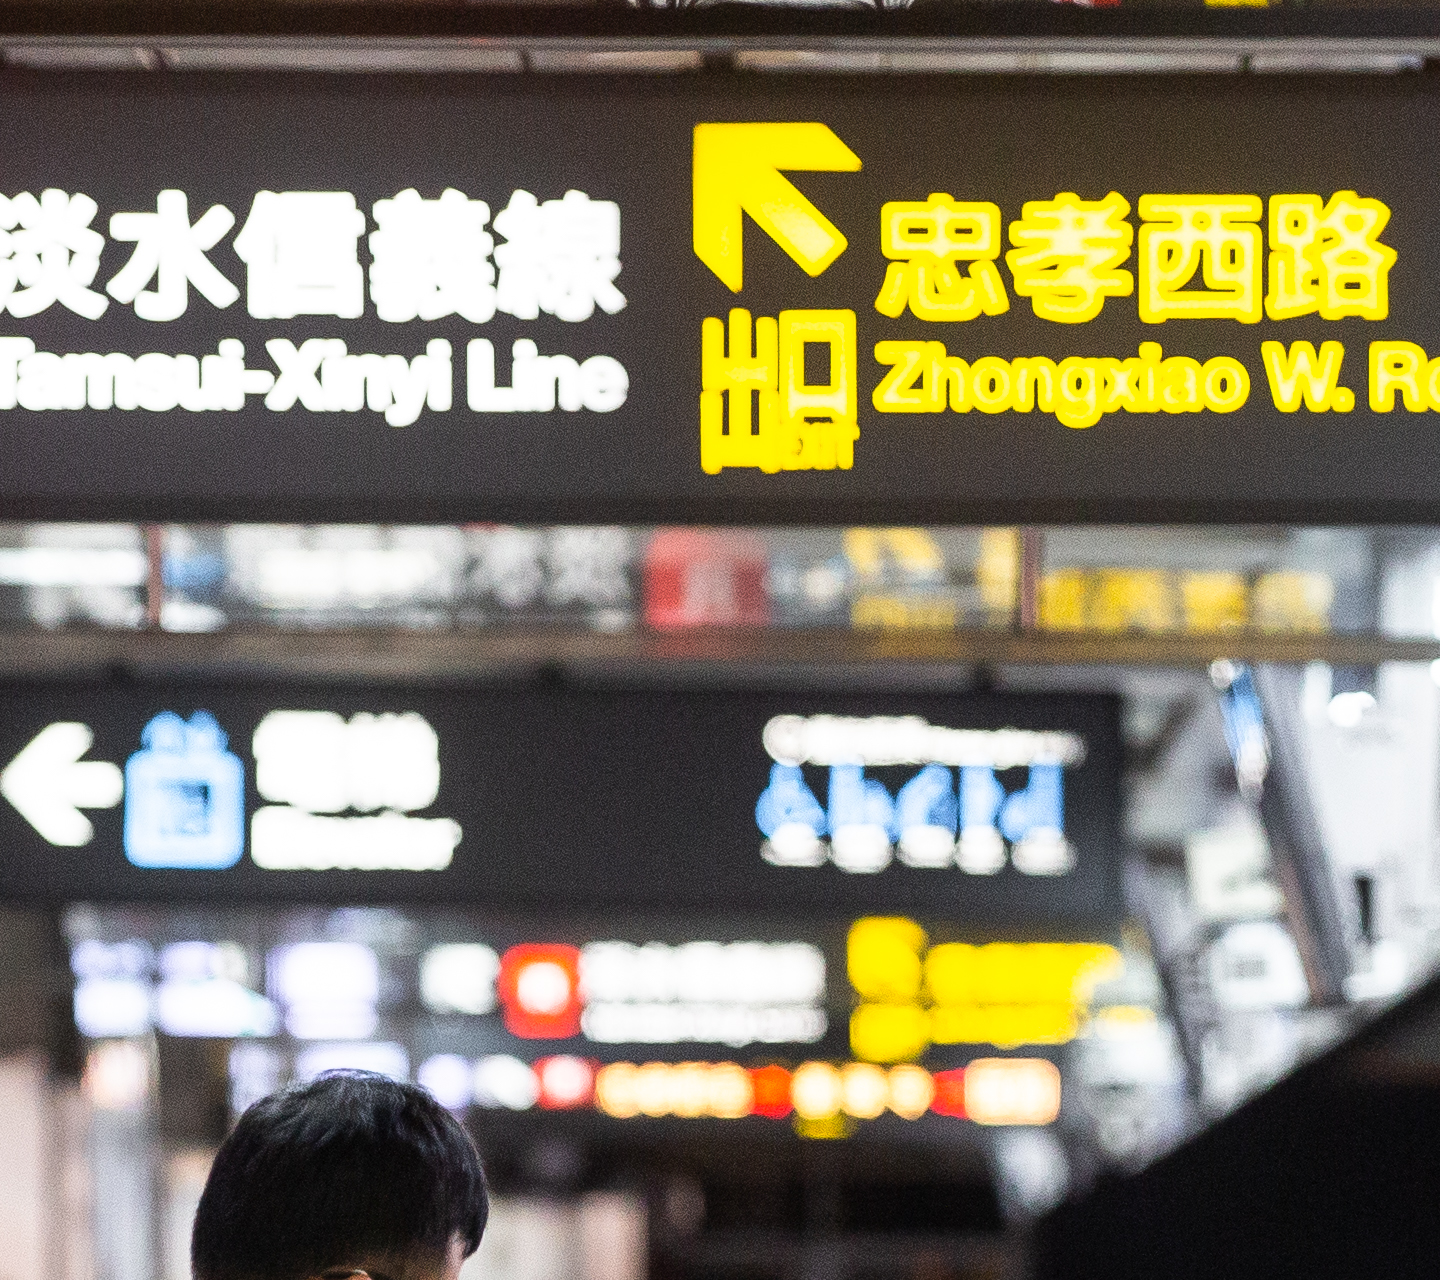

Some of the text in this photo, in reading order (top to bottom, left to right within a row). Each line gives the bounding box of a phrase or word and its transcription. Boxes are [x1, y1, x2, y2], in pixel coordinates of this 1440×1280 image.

[875, 190, 1397, 324] 忠孝西路
[466, 338, 628, 412] Line
[700, 308, 857, 474] 出口
[872, 341, 1250, 428] Zhongxiao
[1261, 341, 1355, 413] W.
